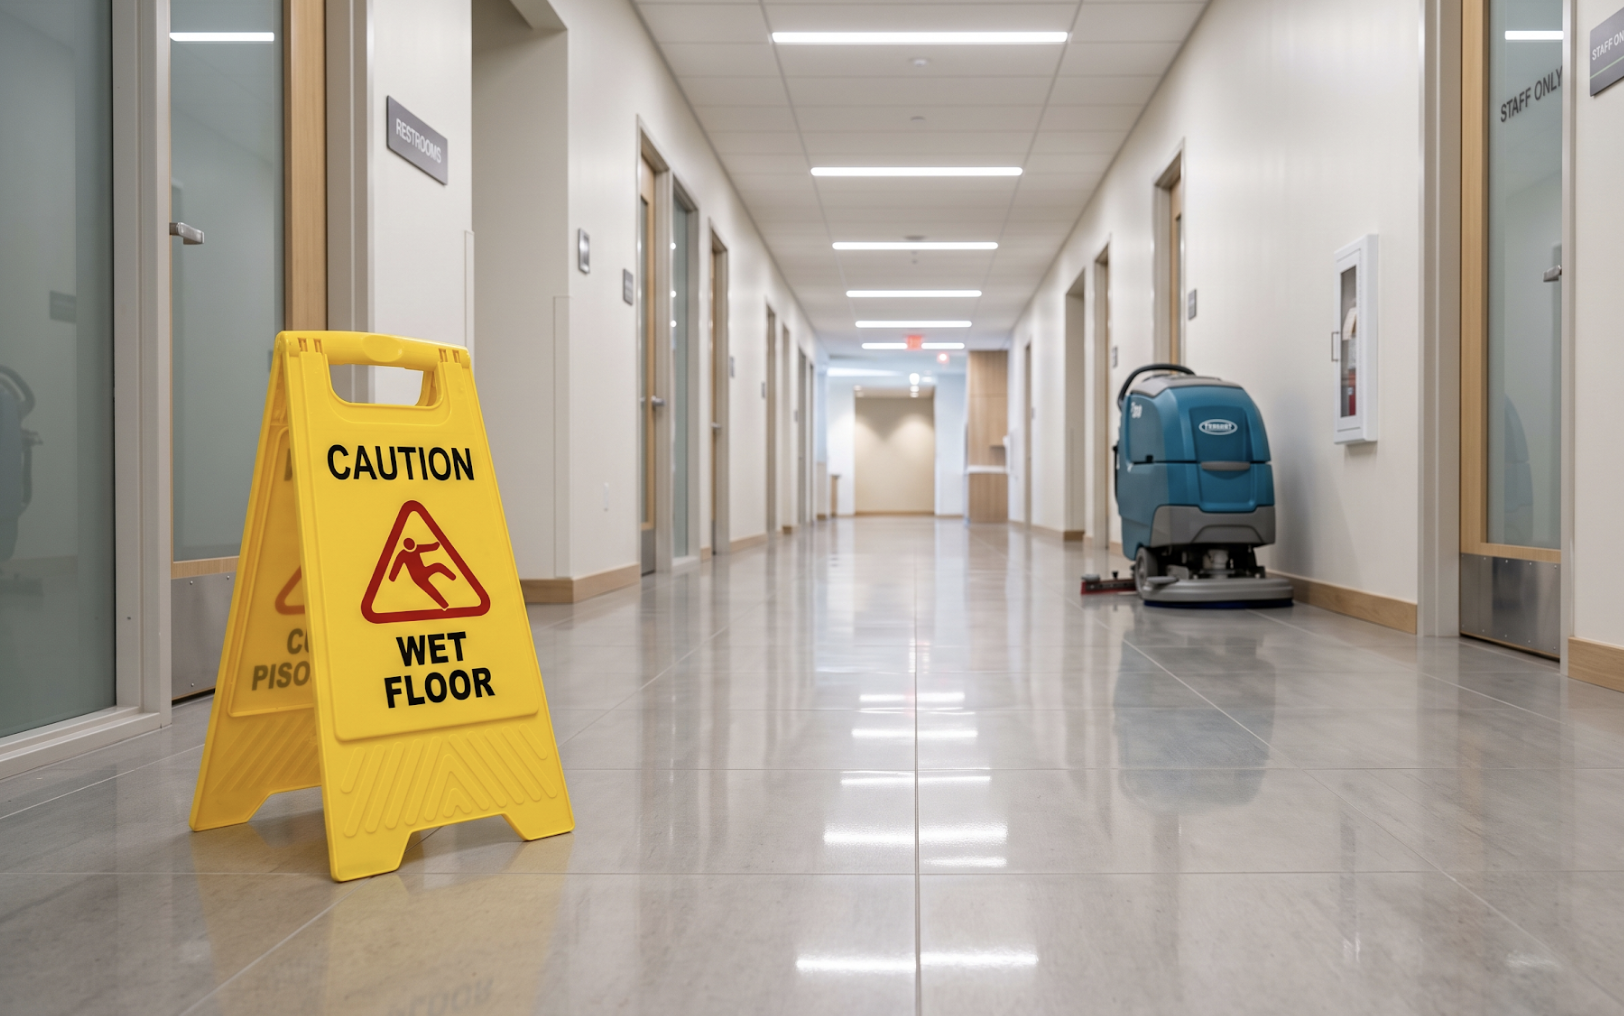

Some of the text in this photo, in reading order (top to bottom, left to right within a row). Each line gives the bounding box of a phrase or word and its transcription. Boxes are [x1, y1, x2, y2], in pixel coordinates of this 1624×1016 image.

[1592, 37, 1613, 60] STAFF
[1500, 65, 1563, 123] STAFF ONLY
[395, 118, 442, 164] RESTROOMS
[327, 444, 475, 481] CAUTION
[396, 631, 467, 667] WET
[252, 660, 311, 691] PISO
[384, 667, 495, 709] FLOOR
